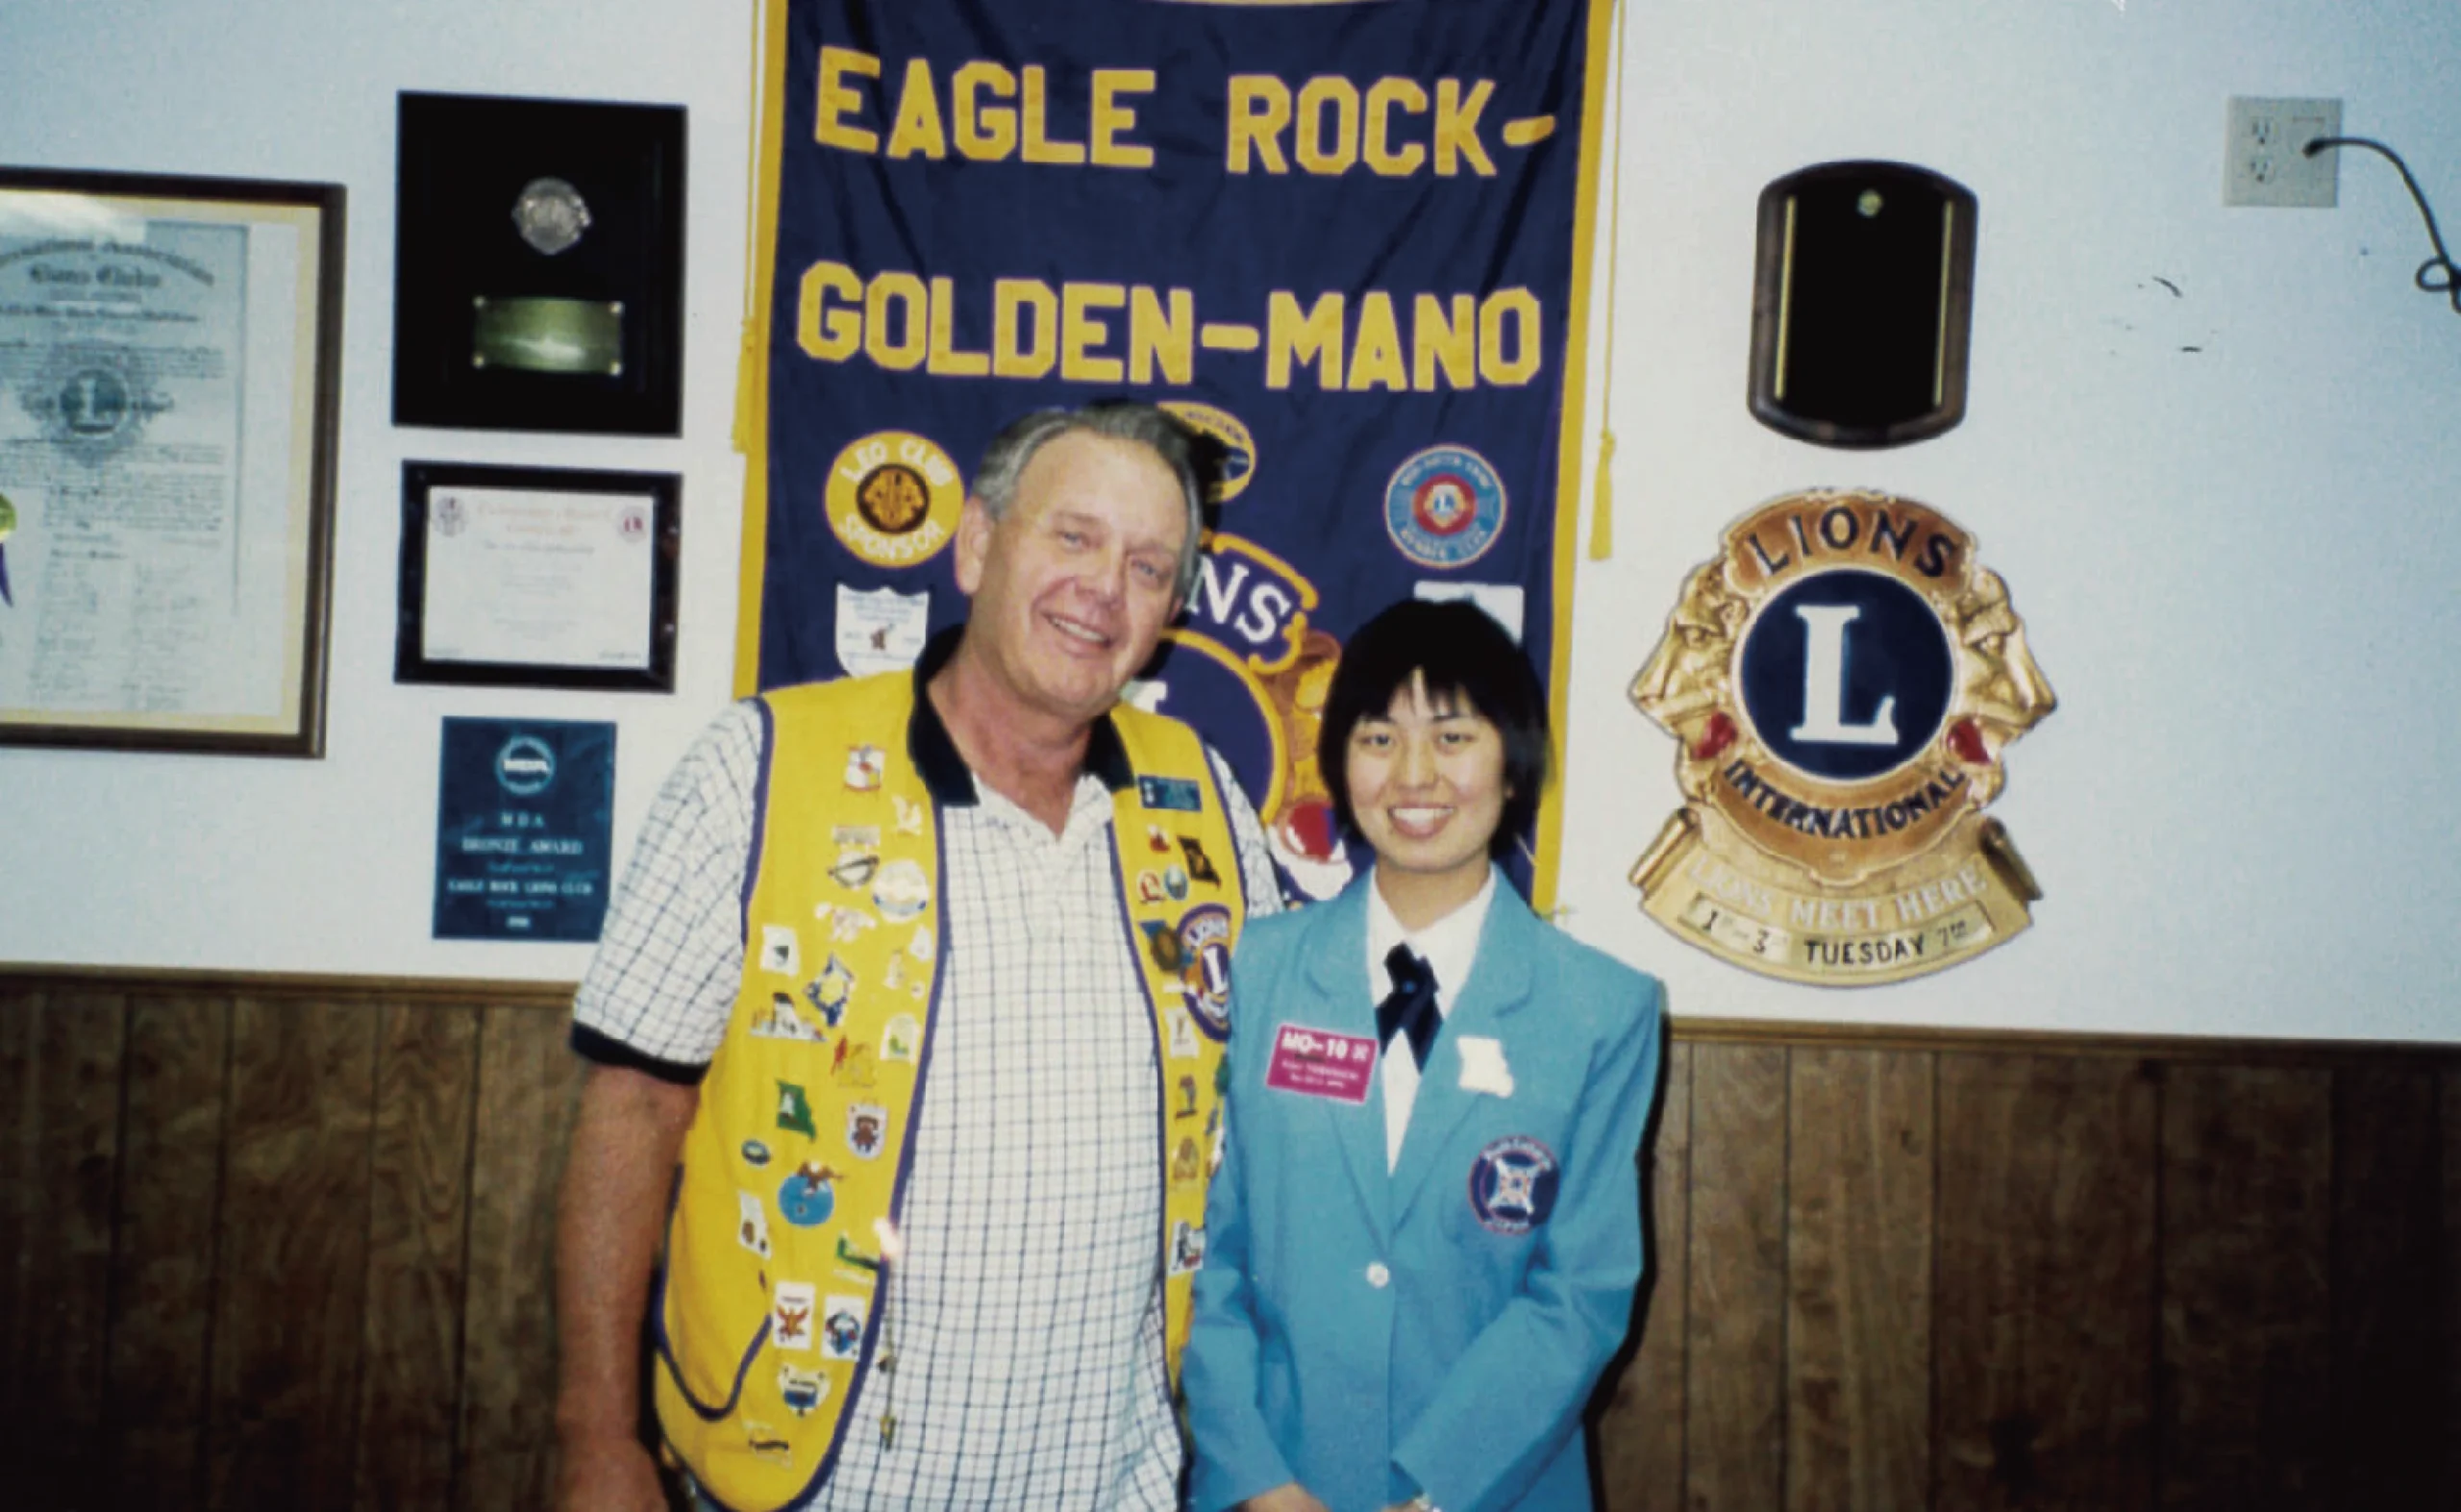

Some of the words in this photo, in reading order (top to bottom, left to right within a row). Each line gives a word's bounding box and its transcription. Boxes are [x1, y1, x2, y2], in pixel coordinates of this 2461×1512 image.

[814, 45, 1156, 168] EAGLE
[1225, 74, 1556, 177] ROCK-
[796, 260, 1541, 392] GOLDEN-MANO
[839, 439, 888, 482] LEO
[1748, 506, 1955, 579] LIONS
[1789, 605, 1900, 746] L
[1724, 758, 1967, 840] INTERNATIONAL
[1790, 891, 1884, 931] MEET
[1895, 862, 1990, 924] HERE
[1803, 932, 1926, 967] TUESDAY
